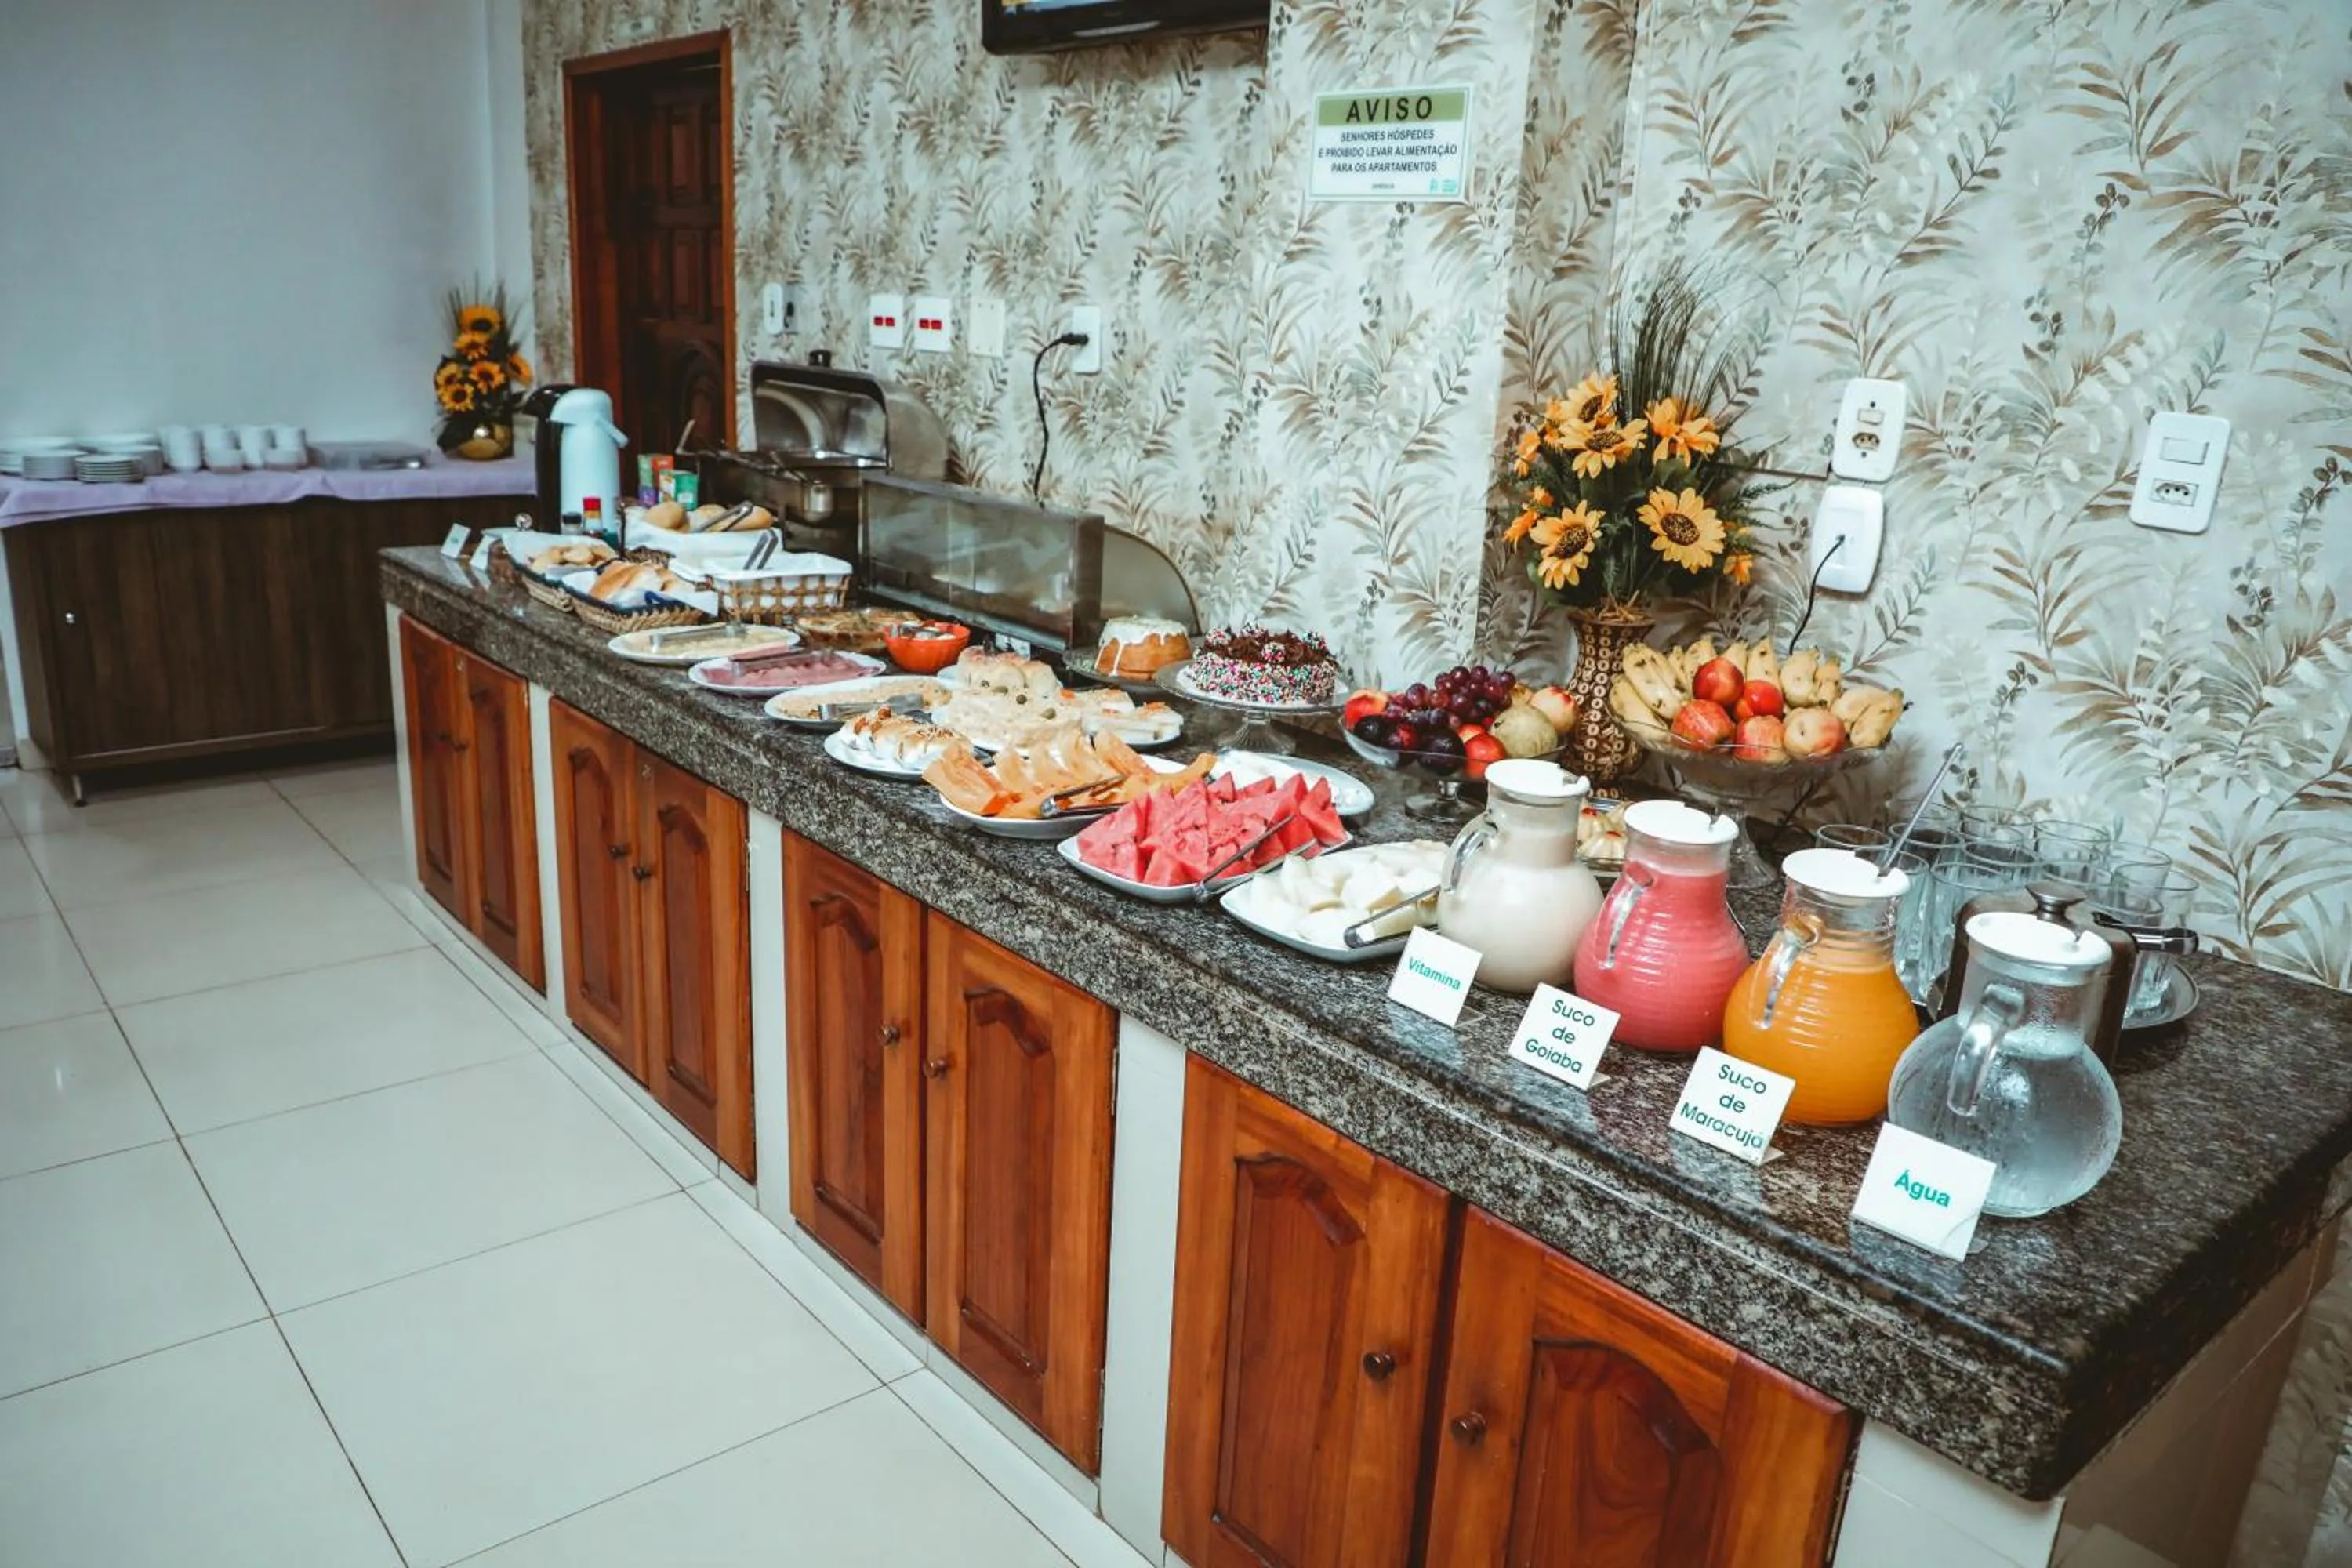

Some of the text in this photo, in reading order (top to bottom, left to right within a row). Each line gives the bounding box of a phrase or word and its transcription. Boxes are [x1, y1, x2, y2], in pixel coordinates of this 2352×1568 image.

[1346, 96, 1432, 122] AVISO
[1341, 128, 1434, 142] SENHORES HÓSPEDES
[1325, 147, 1364, 158] PROIBIDO
[1366, 146, 1393, 157] LEVAR
[1395, 143, 1457, 156] ALIMENTAÇÃO
[1331, 161, 1436, 172] PARA OS APARTAMENTOS
[1409, 956, 1461, 991] Vitamina
[1552, 999, 1595, 1027] Suco
[1552, 1025, 1575, 1044] de
[1525, 1038, 1582, 1073] Goiaba
[1718, 1064, 1766, 1094] Suco
[1719, 1092, 1746, 1114] de
[1893, 1169, 1950, 1208] Água
